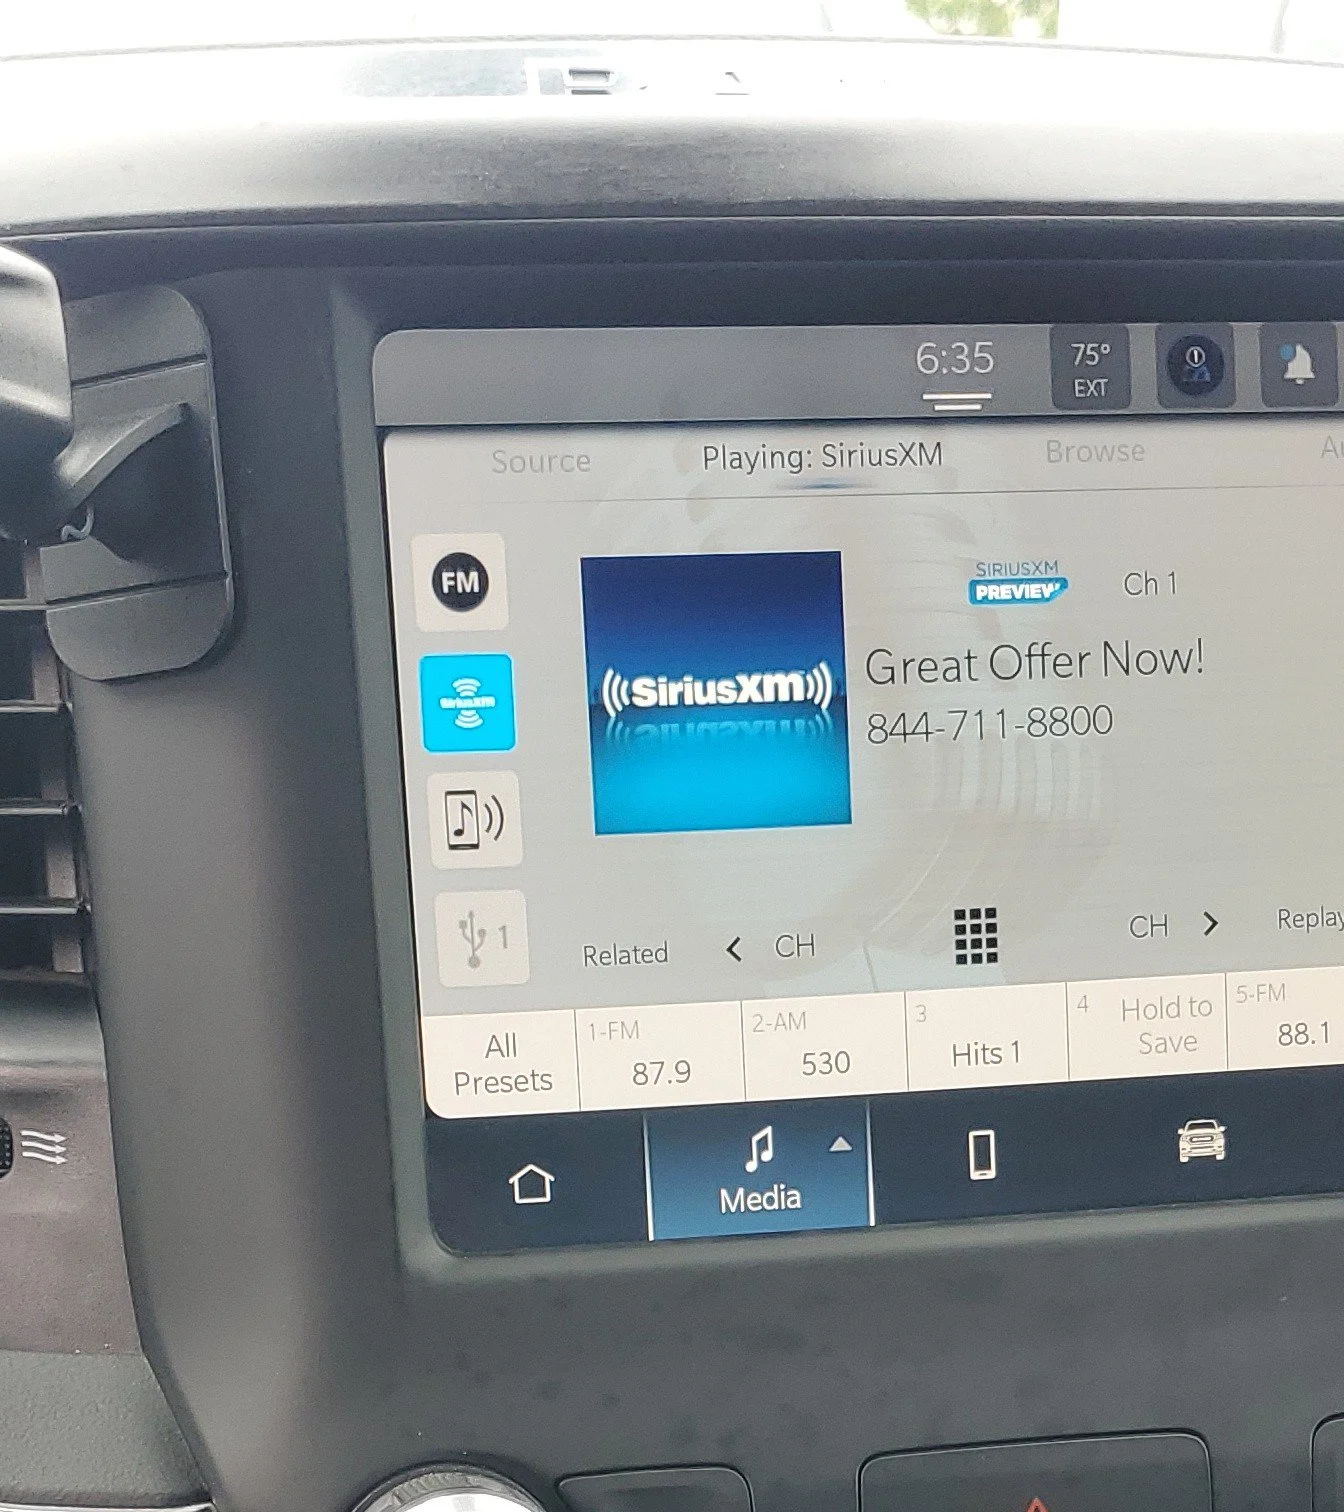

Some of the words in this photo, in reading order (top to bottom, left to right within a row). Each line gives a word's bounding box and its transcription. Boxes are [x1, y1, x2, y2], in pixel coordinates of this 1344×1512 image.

[916, 340, 996, 375] 6:35
[1070, 342, 1112, 368] 75°
[1073, 377, 1109, 400] EXT
[491, 449, 592, 475] Source
[702, 443, 813, 475] Playing:
[821, 440, 944, 469] SiriusXM
[1045, 438, 1146, 465] Browse
[975, 560, 1060, 577] SIRIUSXM
[440, 571, 481, 595] FM
[975, 580, 1060, 601] PREVIEW
[1123, 571, 1159, 597] Ch
[1167, 571, 1178, 596] 1
[865, 647, 979, 686] Great
[989, 640, 1092, 681] Offer
[1102, 637, 1205, 678] Now!
[867, 703, 1114, 745] 844-711-8800
[498, 924, 509, 949] 1
[1129, 914, 1169, 939] CH
[582, 941, 669, 968] Related
[774, 932, 816, 959] CH
[1076, 994, 1089, 1014] 4
[1235, 982, 1287, 1004] 5-FM
[751, 1010, 808, 1034] 2-AM
[915, 1004, 928, 1024] 3
[1121, 996, 1184, 1024] Hold
[1188, 997, 1214, 1018] to
[588, 1019, 641, 1042] 1-FM
[1138, 1031, 1199, 1056] Save
[1277, 1021, 1331, 1047] 88.1
[485, 1032, 518, 1060] All
[952, 1041, 1002, 1068] Hits
[1010, 1039, 1020, 1065] 1
[631, 1060, 692, 1087] 87.9
[801, 1049, 852, 1077] 530
[453, 1069, 553, 1096] Presets
[719, 1185, 802, 1215] Media
